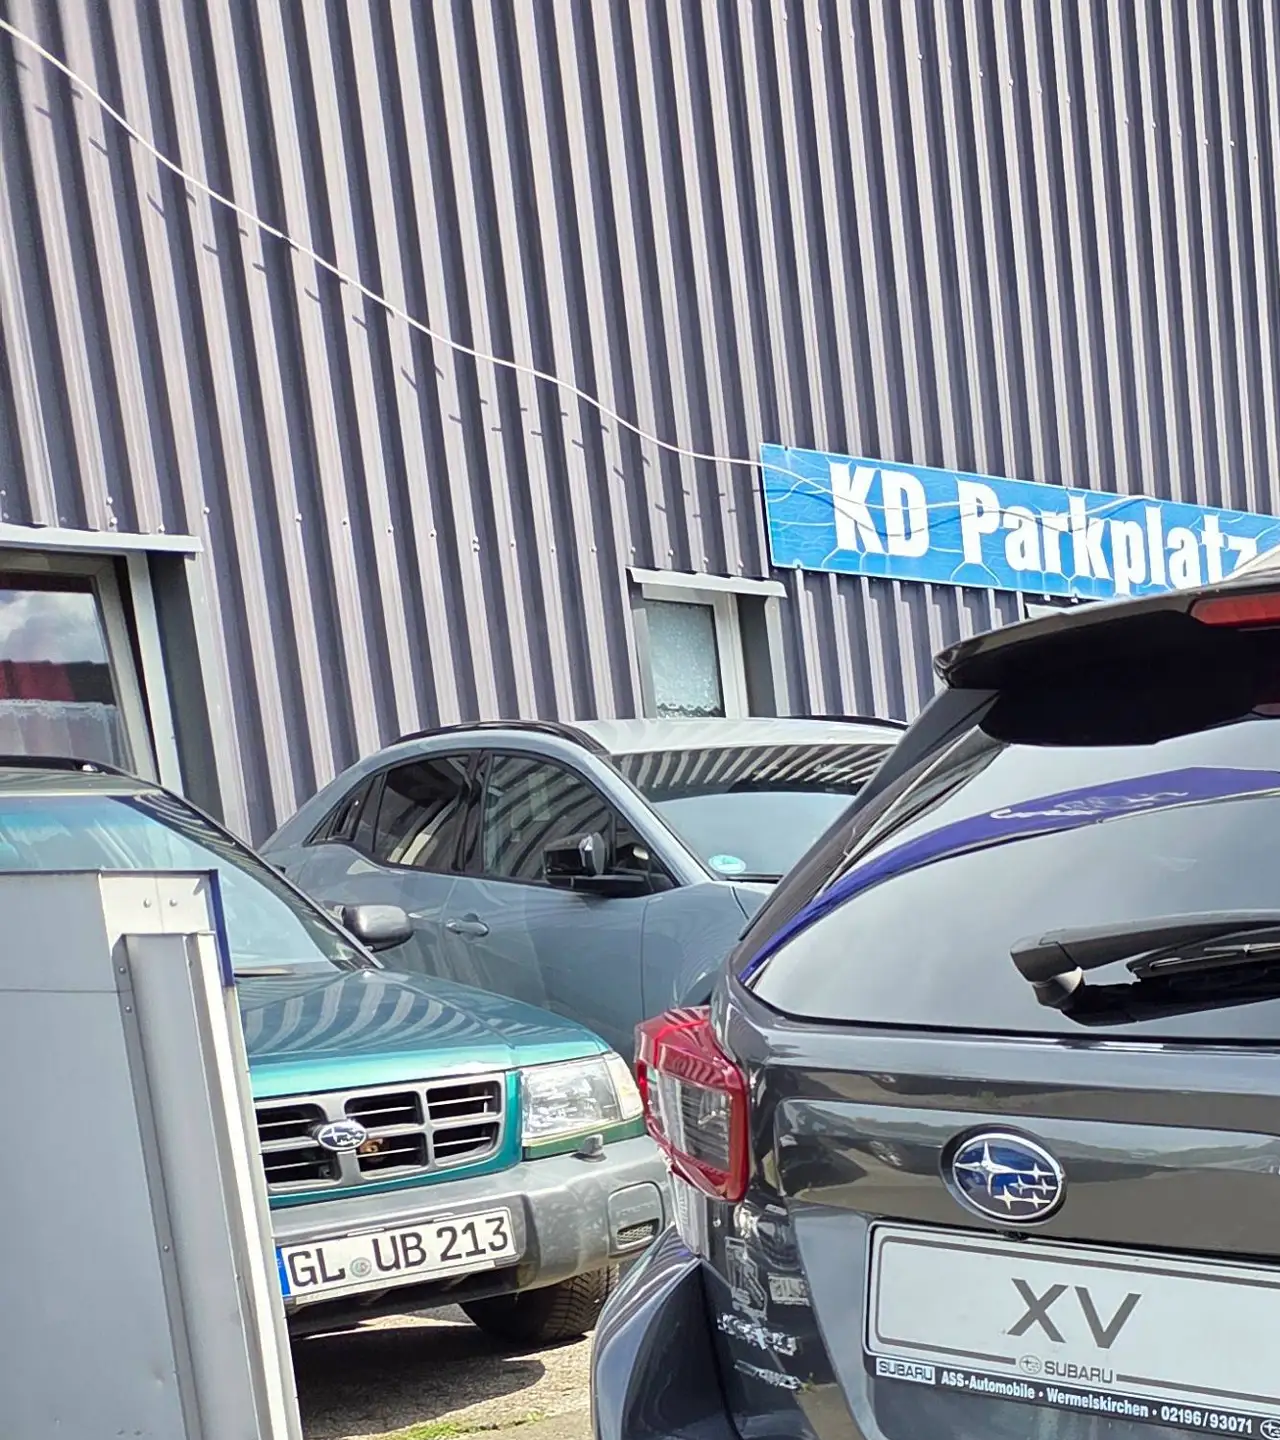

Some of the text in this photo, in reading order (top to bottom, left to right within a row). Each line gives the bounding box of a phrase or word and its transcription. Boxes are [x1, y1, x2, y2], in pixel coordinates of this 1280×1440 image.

[829, 461, 929, 558] KD
[286, 1215, 509, 1288] GL UB 213
[1006, 1277, 1143, 1349] XV
[878, 1360, 934, 1382] SUBARU
[1044, 1360, 1114, 1384] SUBARU
[1046, 1387, 1149, 1418] Wermelskirchen
[1160, 1406, 1253, 1434] 02196/93071
